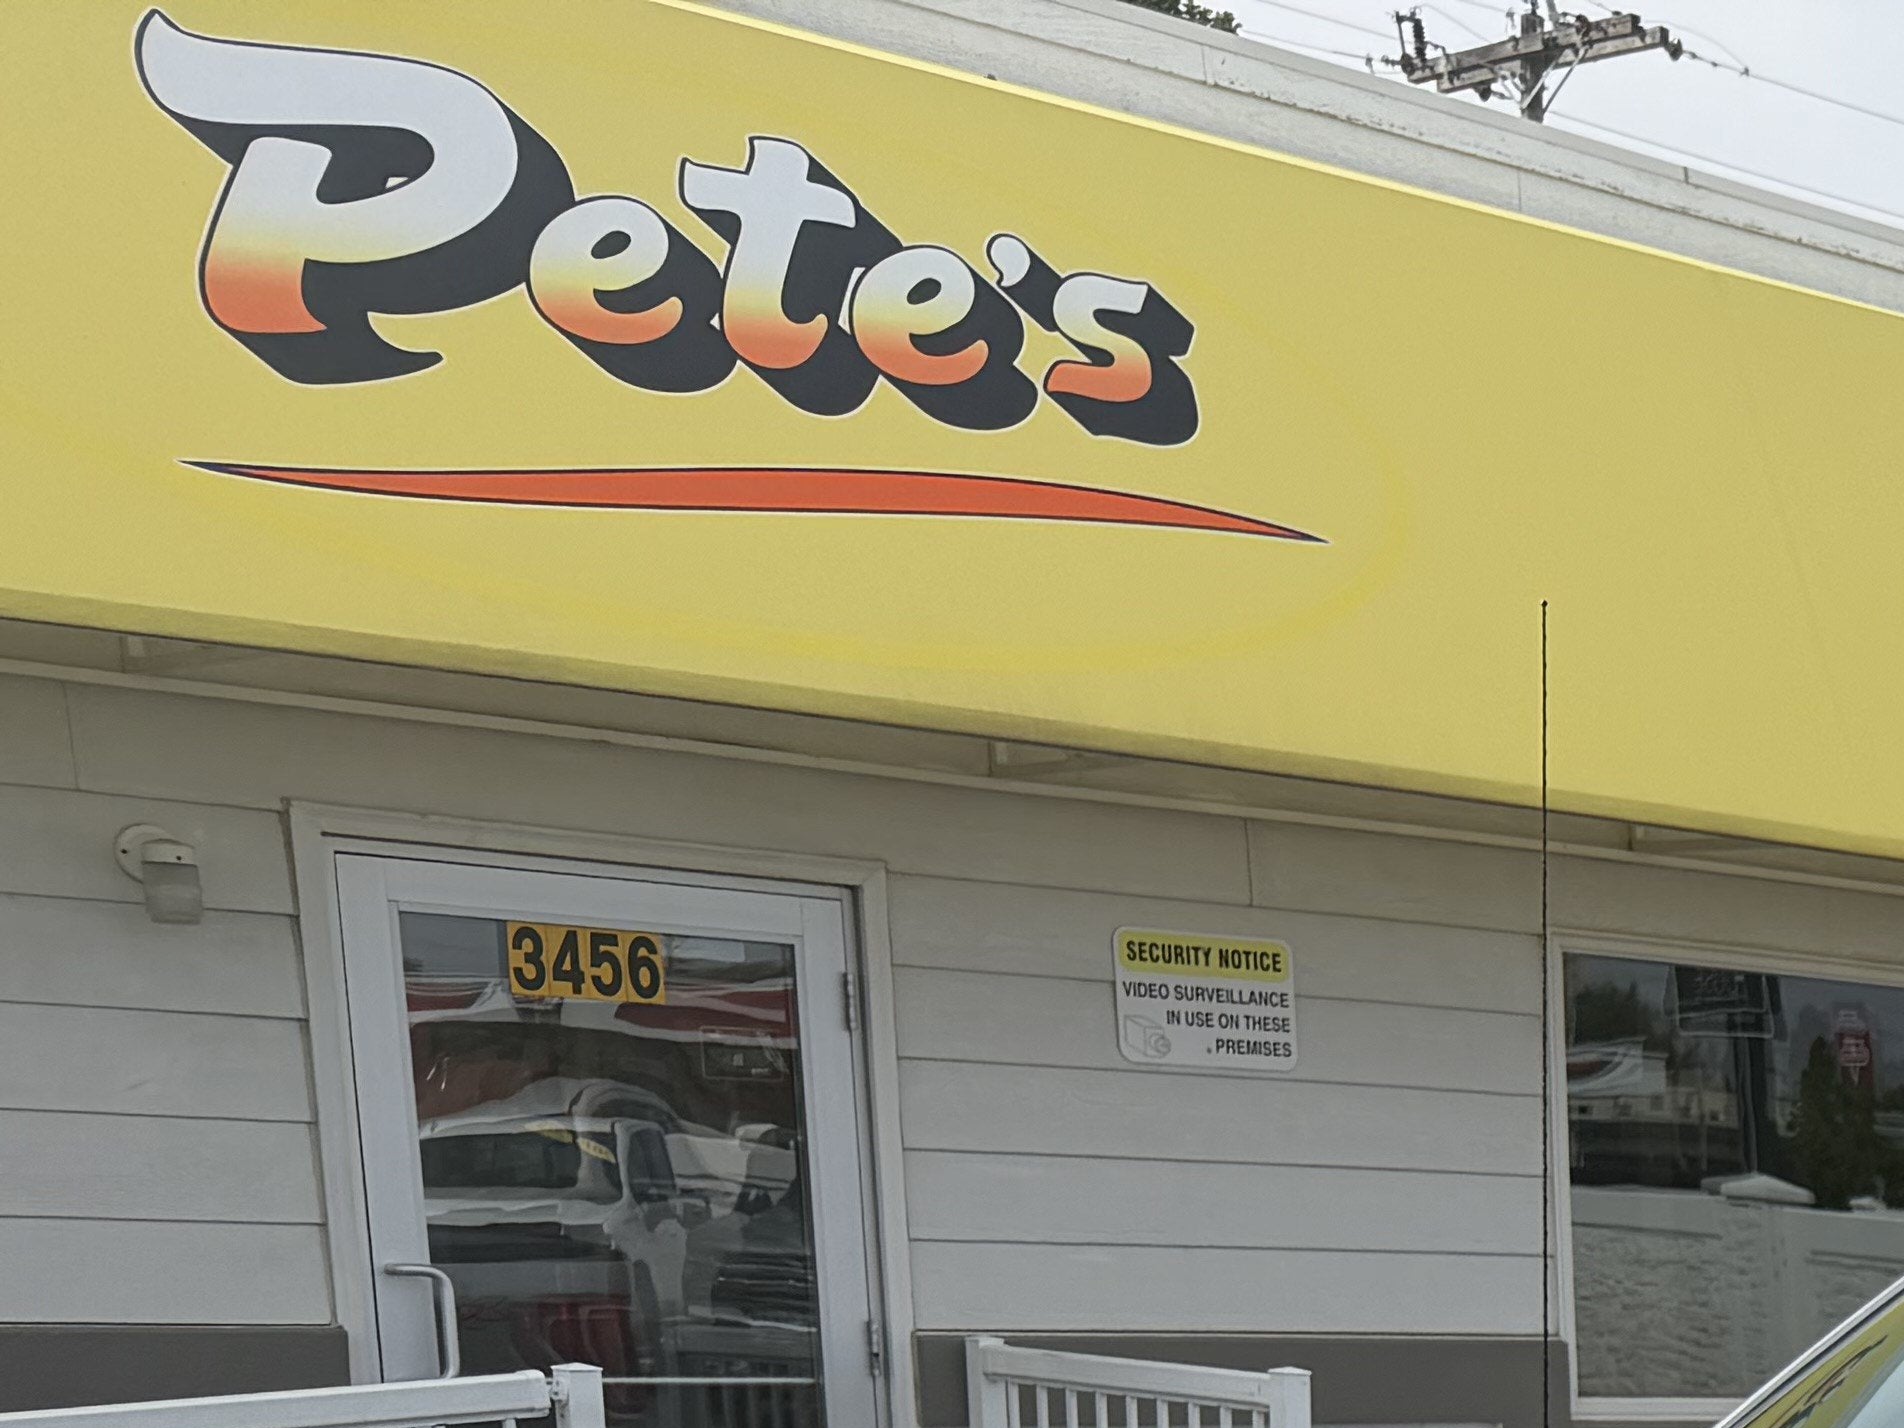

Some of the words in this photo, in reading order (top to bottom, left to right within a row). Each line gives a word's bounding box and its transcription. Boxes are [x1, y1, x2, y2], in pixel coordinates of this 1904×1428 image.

[136, 8, 1200, 446] Pete's
[512, 926, 661, 999] 3456
[1126, 940, 1212, 967] SECURITY
[1218, 948, 1282, 973] NOTICE
[1123, 981, 1170, 1000] VIDEO
[1174, 984, 1290, 1009] SURVEILLANCE
[1167, 1010, 1181, 1025] IN
[1185, 1011, 1214, 1028] USE
[1218, 1013, 1239, 1030] ON
[1243, 1015, 1291, 1033] THESE
[1215, 1038, 1292, 1058] PREMISES
